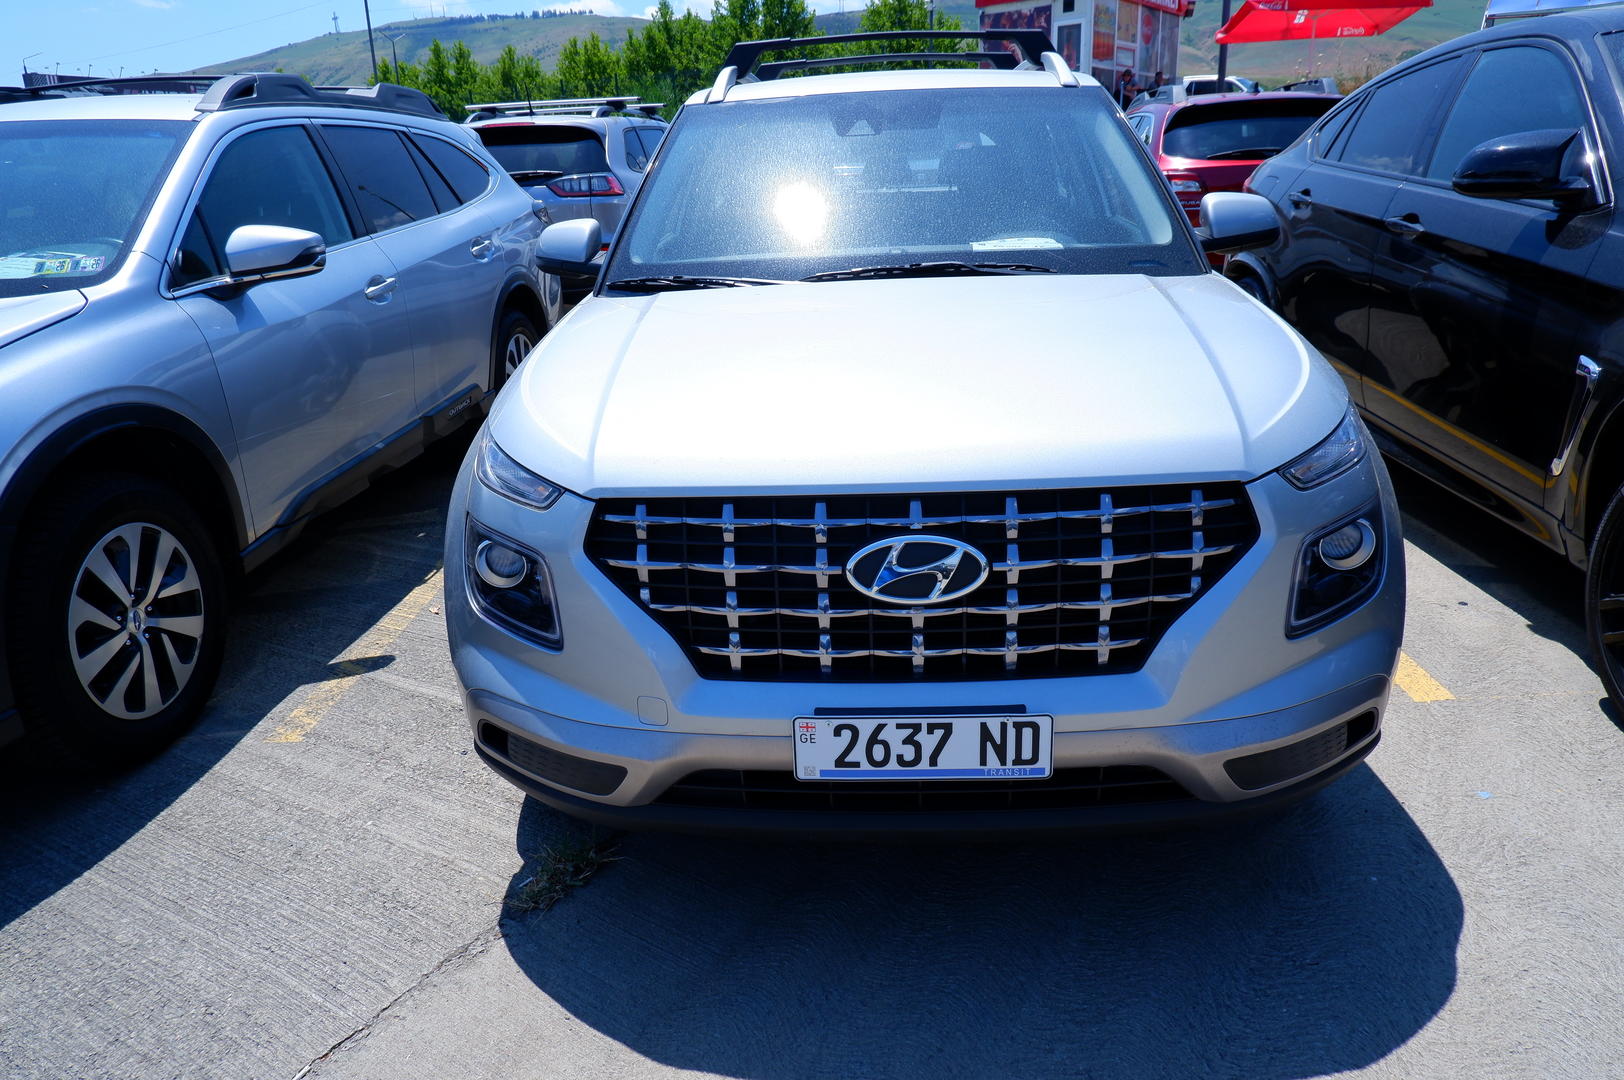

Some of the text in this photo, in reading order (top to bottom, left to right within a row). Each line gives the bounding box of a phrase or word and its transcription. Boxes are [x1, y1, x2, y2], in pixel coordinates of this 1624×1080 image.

[799, 733, 817, 744] GE
[833, 721, 1041, 768] 2637 ND
[984, 768, 1032, 776] TRANSIT
